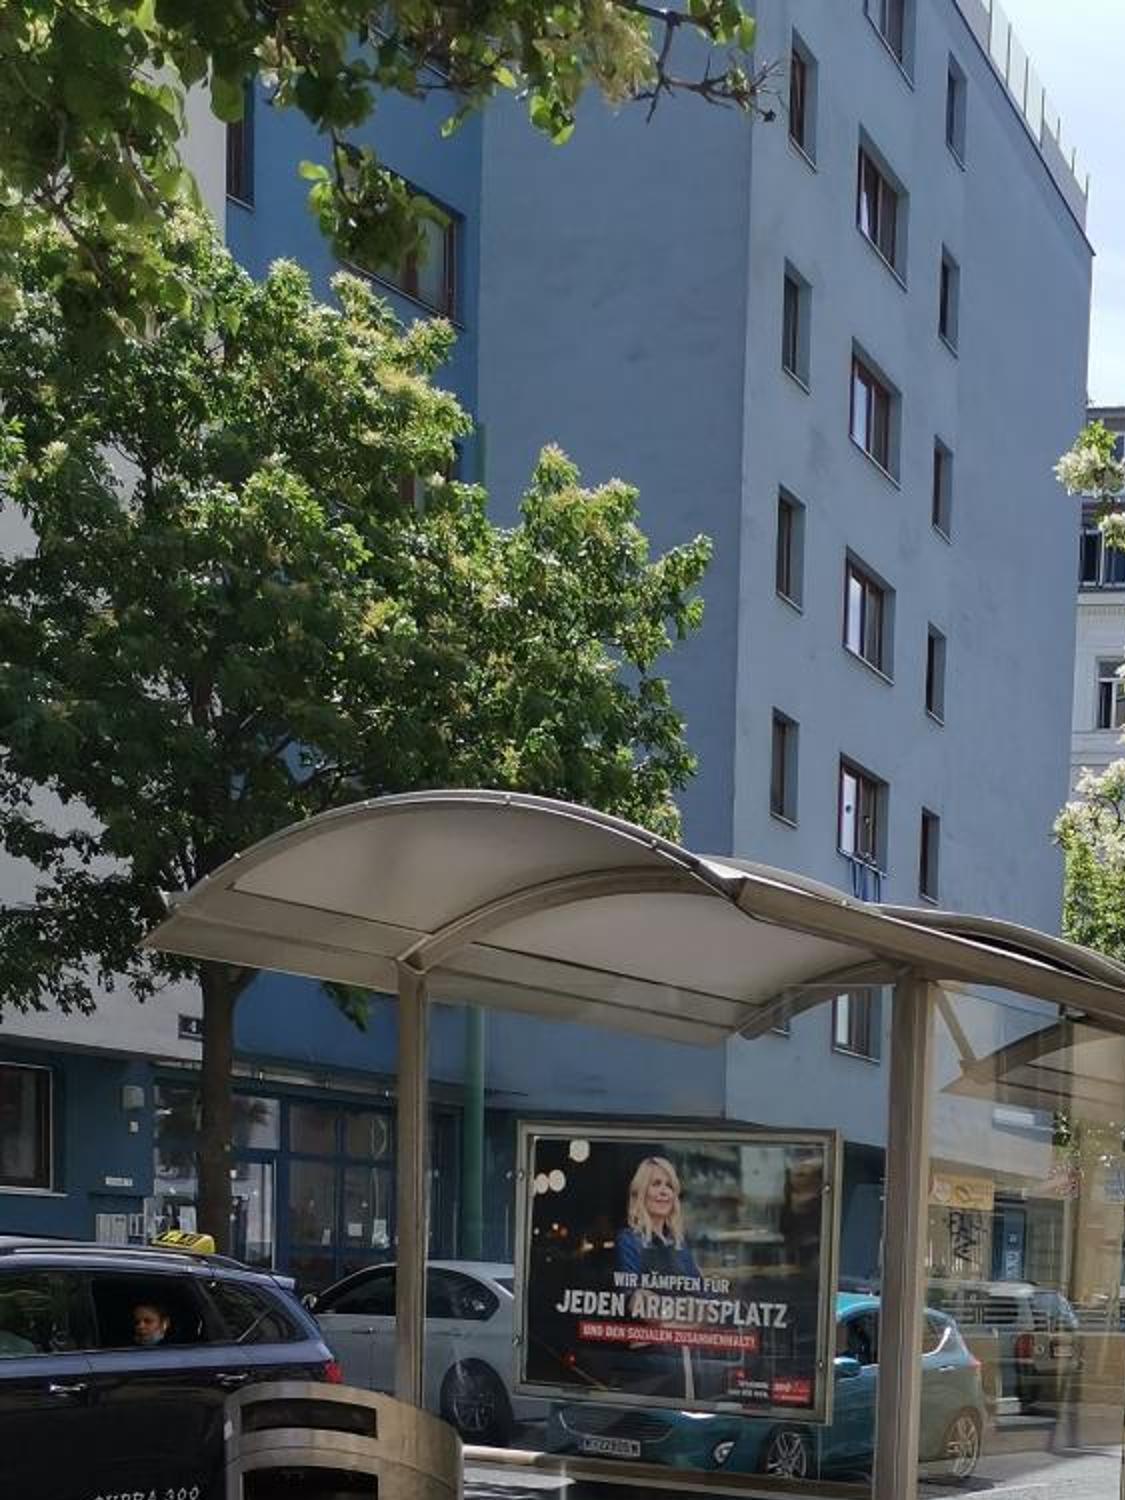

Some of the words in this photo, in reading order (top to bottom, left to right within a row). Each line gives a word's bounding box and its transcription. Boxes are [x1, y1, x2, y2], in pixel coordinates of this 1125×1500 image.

[613, 1270, 637, 1287] WIR
[640, 1271, 701, 1291] KÄMPFEN
[704, 1277, 730, 1294] FÜR
[556, 1288, 625, 1317] JEDEN
[631, 1292, 787, 1328] ARBEITSPLATZ
